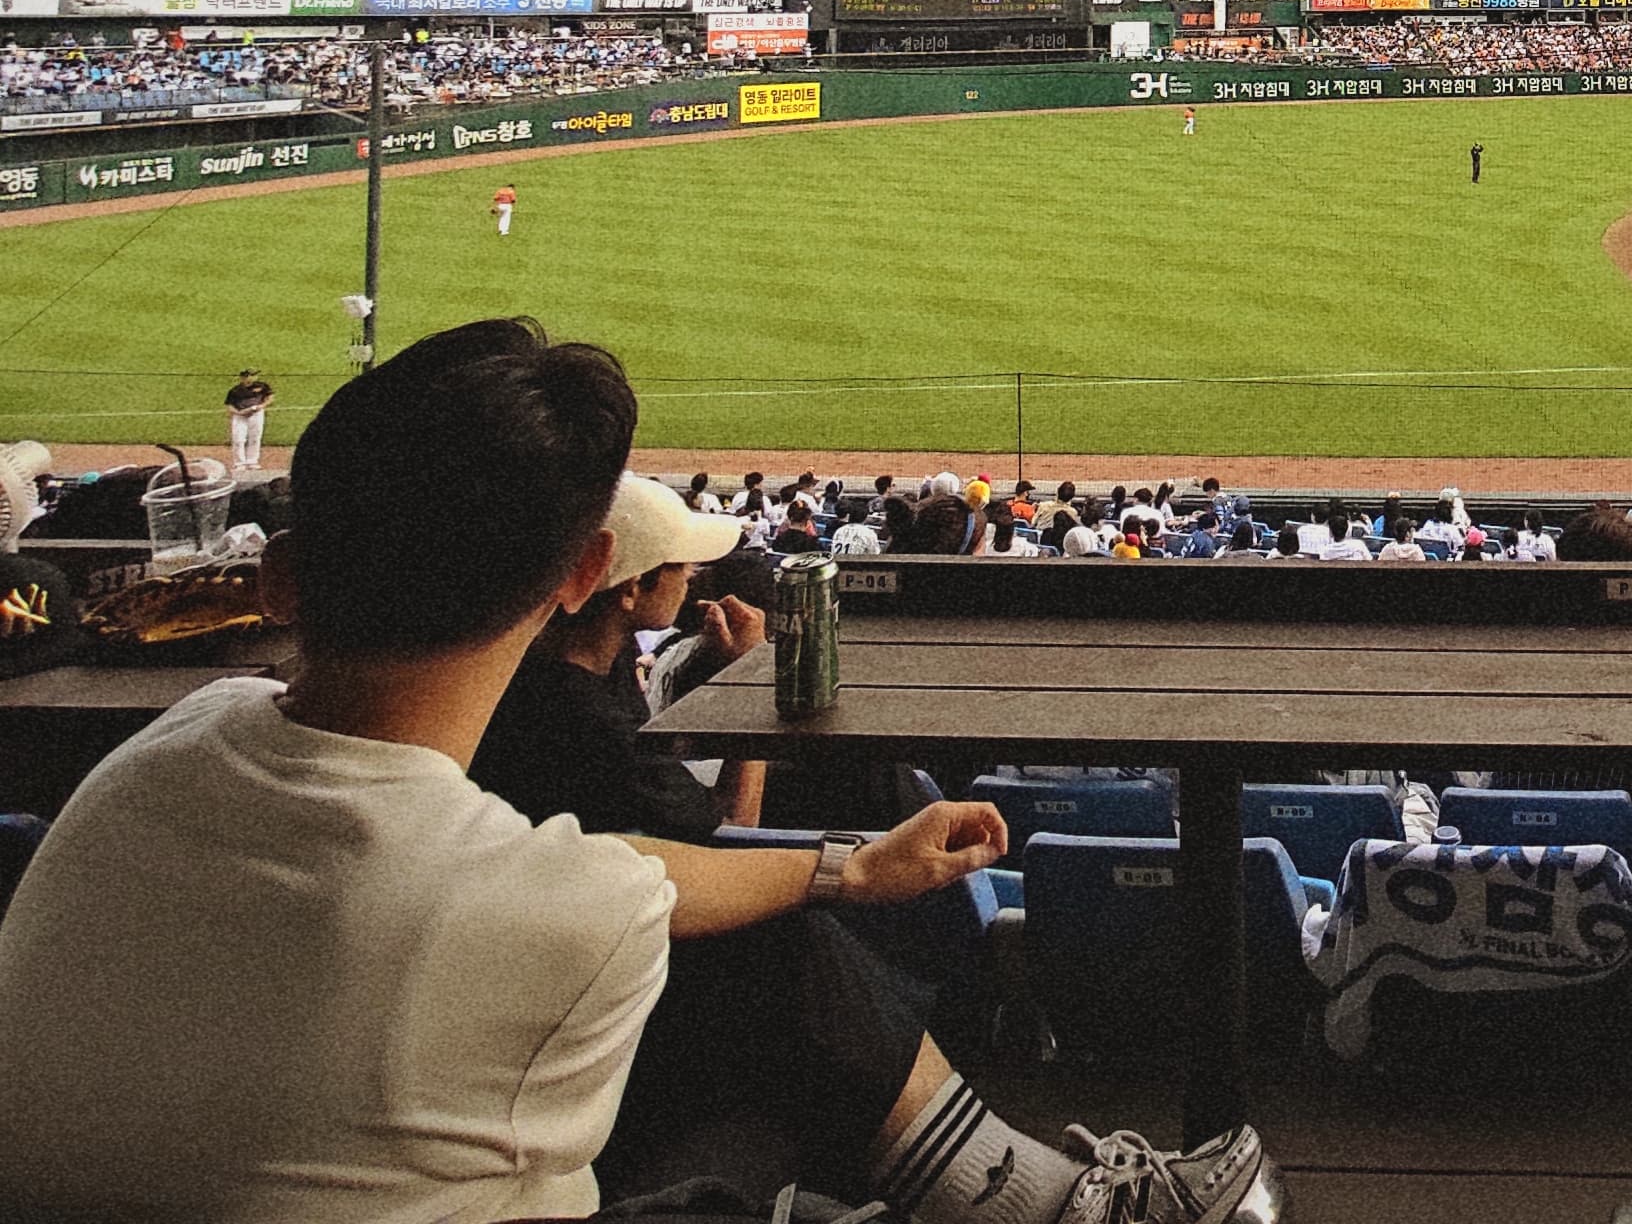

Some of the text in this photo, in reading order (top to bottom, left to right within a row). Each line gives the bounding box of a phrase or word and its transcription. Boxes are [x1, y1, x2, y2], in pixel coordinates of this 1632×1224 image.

[583, 21, 636, 31] KIDS ZONE
[901, 36, 949, 52] 갤러리아
[1025, 33, 1066, 49] 갤러리아
[1213, 81, 1290, 99] 3H 지압침대
[1307, 79, 1382, 96] 3H 지압침대
[1402, 78, 1477, 94] 3H 지압침대
[1492, 77, 1563, 93] 3H 지압침대
[1581, 76, 1602, 91] 3H
[745, 90, 768, 105] 영동
[669, 102, 729, 124] 충남도립대
[745, 106, 770, 117] GOLF
[780, 103, 817, 115] RESORT
[568, 111, 633, 134] 아이클타임
[200, 146, 265, 175] Sunjin
[270, 143, 309, 167] 선진
[100, 163, 175, 188] 카미스타
[844, 575, 887, 588] P-04
